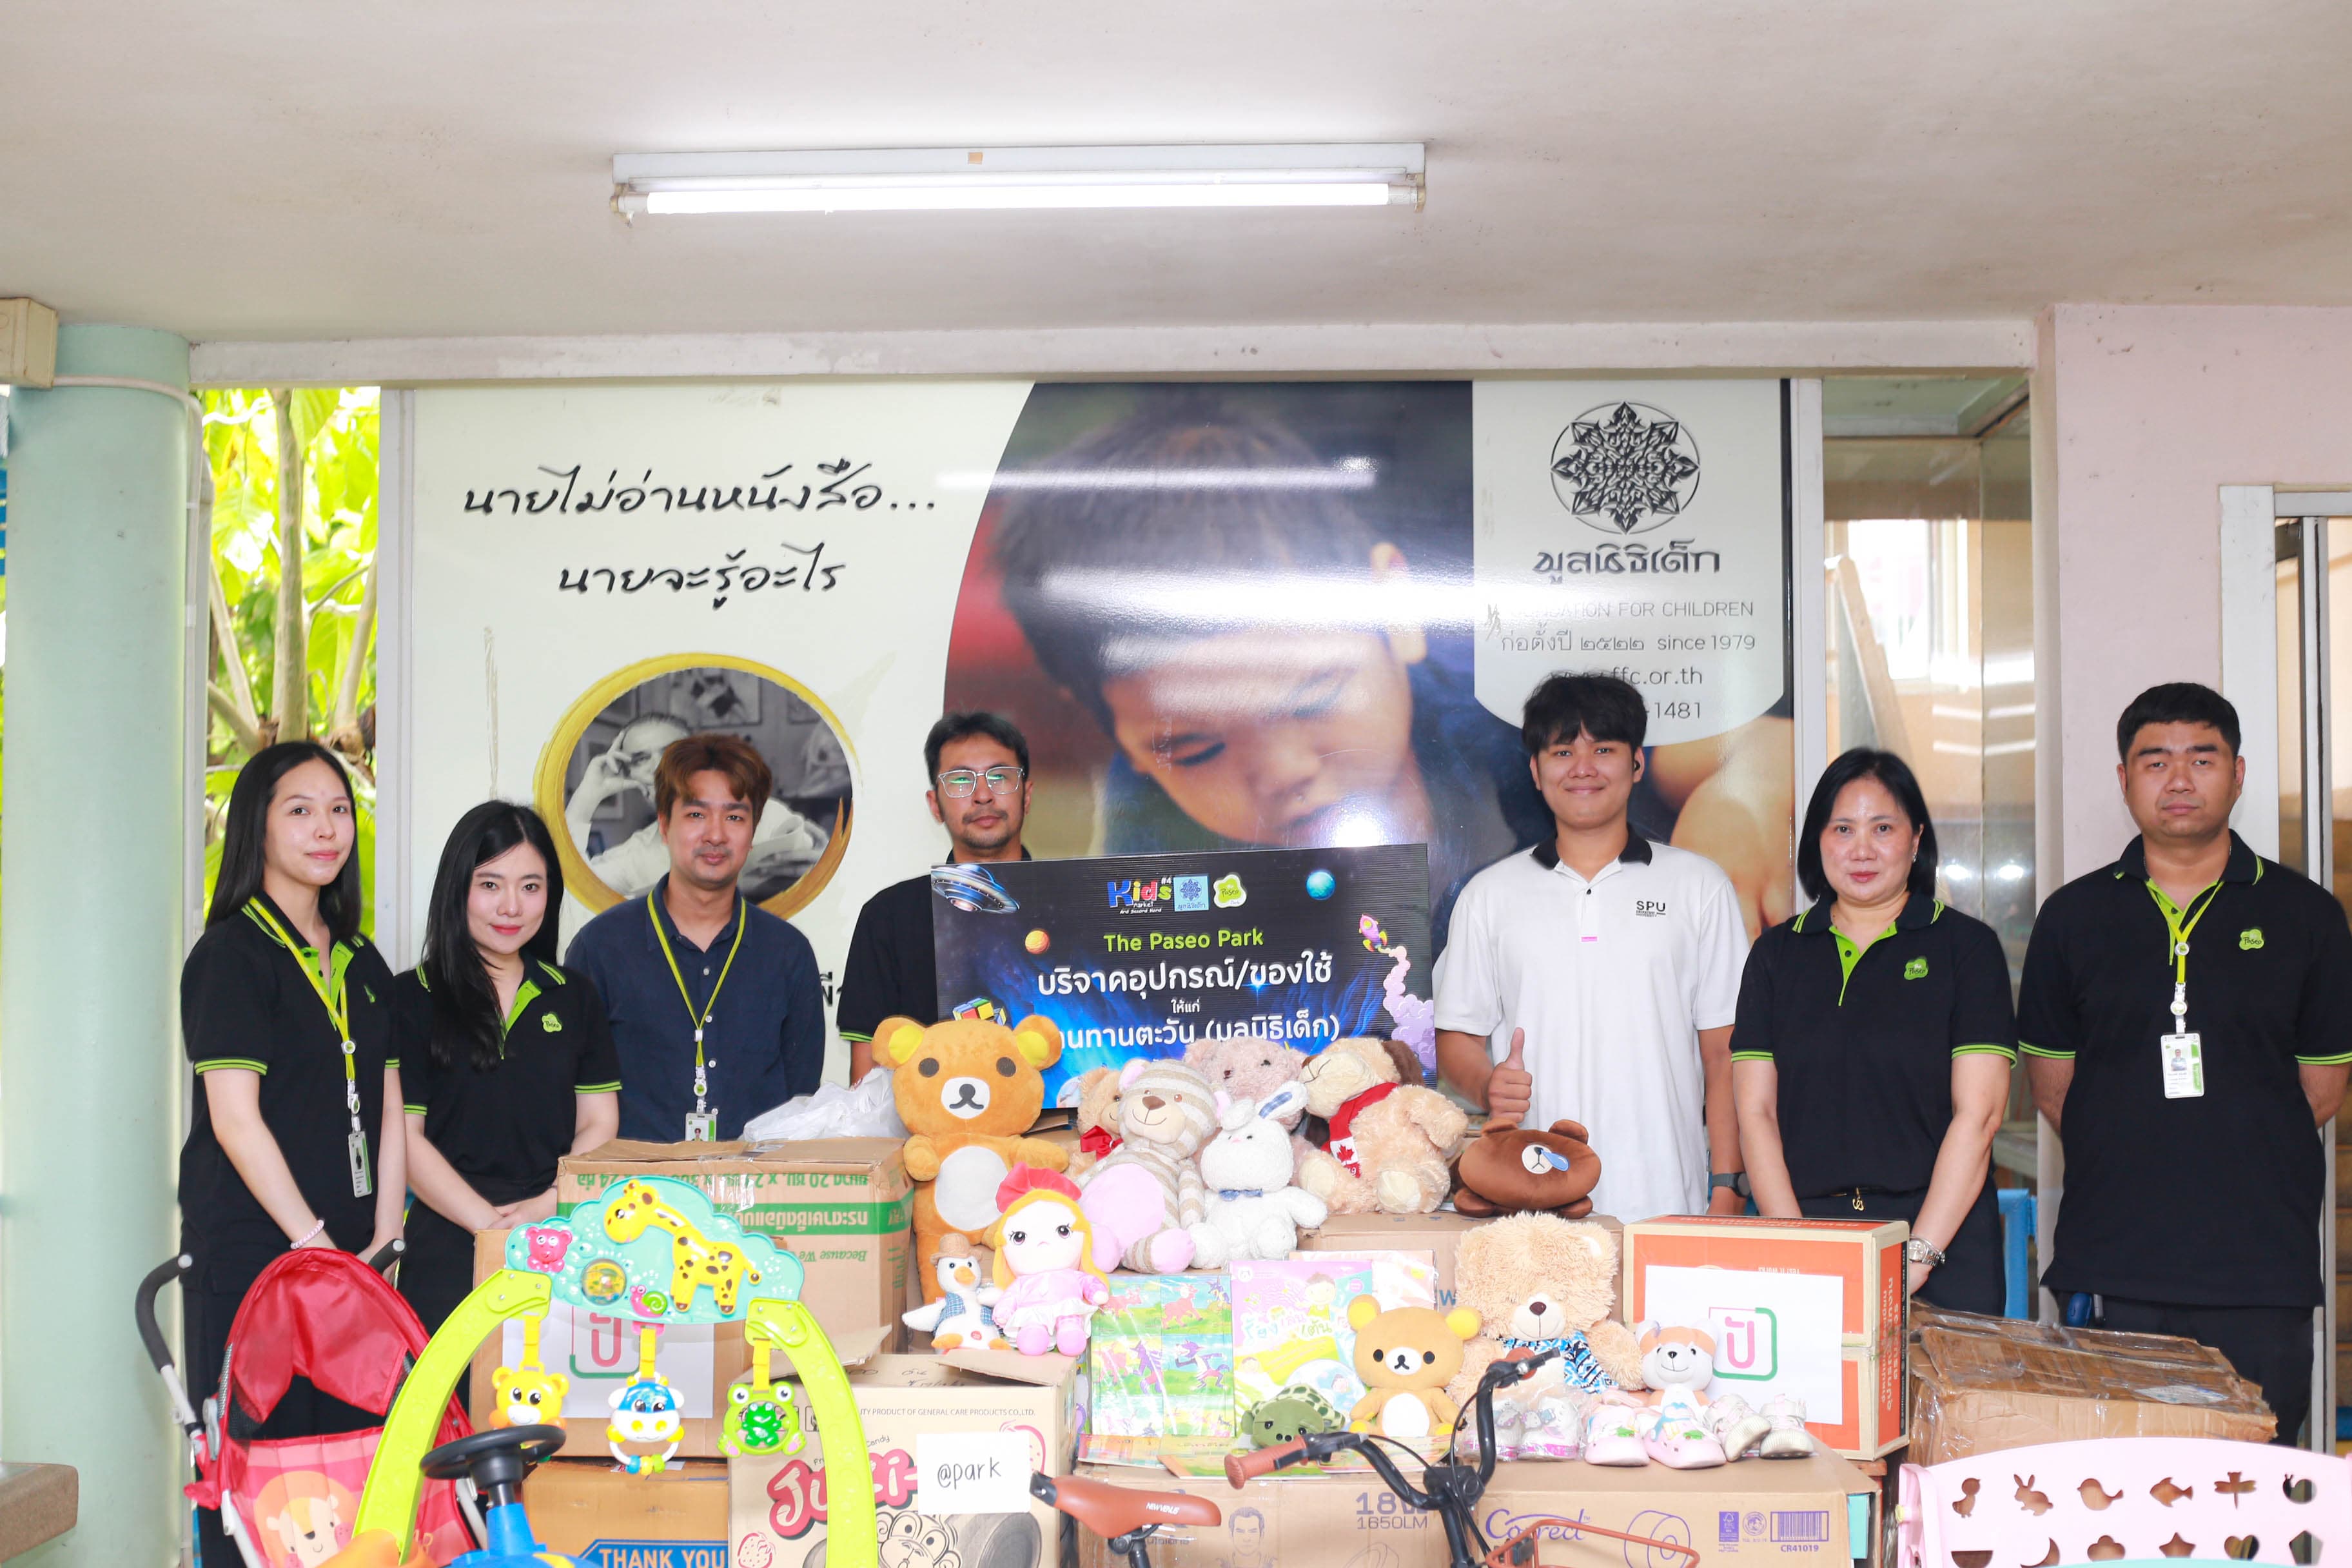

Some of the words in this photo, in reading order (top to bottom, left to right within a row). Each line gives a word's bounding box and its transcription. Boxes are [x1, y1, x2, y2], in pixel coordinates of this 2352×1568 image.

[1532, 538, 1720, 585] มูลนิธิเด็ก
[559, 540, 846, 611] นายจะรู้อะไร
[1619, 602, 1654, 617] FOR
[1661, 602, 1754, 617] CHILDREN
[1501, 622, 1572, 651] ก่อตั้งปี
[1580, 636, 1645, 651] ๒๕๒๒
[1657, 634, 1705, 651] since
[1711, 634, 1756, 651] 1979
[1107, 879, 1172, 908] Kids
[1636, 900, 1665, 912] SPU
[1103, 934, 1142, 952] The
[1150, 932, 1211, 951] Paseo
[1217, 927, 1265, 948] Park
[1171, 998, 1200, 1014] ให้แก่
[808, 1173, 830, 1188] 20
[799, 1251, 817, 1262] We
[819, 1250, 867, 1262] Because
[872, 1407, 906, 1417] PRODUCT
[906, 1407, 917, 1417] OF
[917, 1407, 949, 1417] GENERAL
[950, 1407, 968, 1417] CARE
[970, 1407, 1008, 1417] PRODUCTS
[936, 1456, 1002, 1491] @park
[1357, 1516, 1428, 1530] 1650LM
[1780, 1544, 1819, 1553] CR41019
[599, 1549, 674, 1568] THANK
[681, 1549, 727, 1568] YOU
